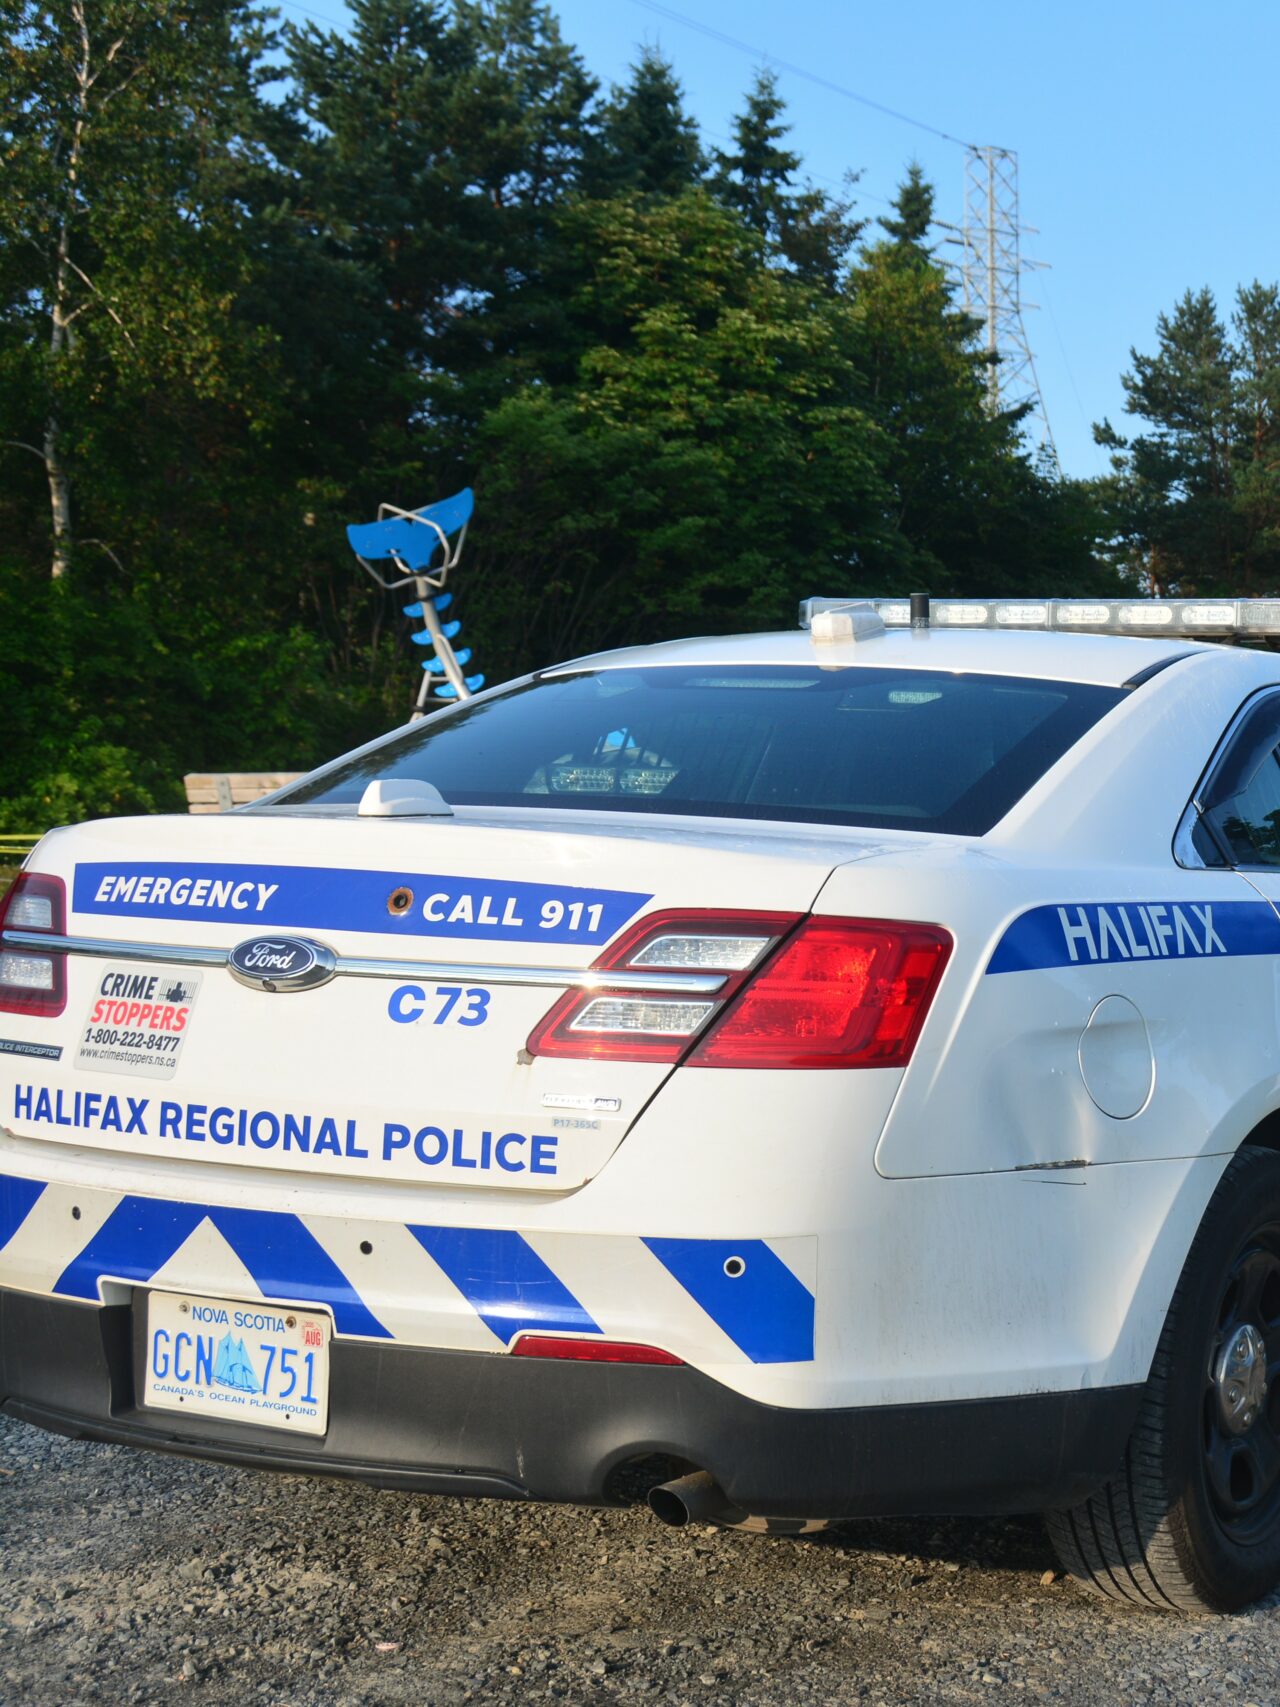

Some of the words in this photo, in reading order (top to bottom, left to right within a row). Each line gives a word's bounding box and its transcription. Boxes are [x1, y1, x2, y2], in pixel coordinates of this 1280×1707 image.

[94, 875, 279, 911] EMERGENCY
[421, 892, 524, 927] CALL
[538, 898, 604, 932] 911
[1056, 904, 1228, 962] HALIFAX
[244, 942, 297, 969] Ford
[99, 972, 159, 1000] CRIME
[90, 999, 190, 1032] STOPPERS
[15, 1044, 60, 1057] INTERCEPTOR
[84, 1027, 181, 1053] 1-800-222-8477
[79, 1047, 177, 1068] www.crimestoppers.ns.ca
[13, 1083, 150, 1136] HALIFAX
[159, 1102, 370, 1159] REGIONAL
[381, 1124, 559, 1175] POLICE
[192, 1305, 229, 1325] NOVA
[233, 1311, 286, 1333] SCOTIA
[304, 1329, 321, 1346] AUG
[152, 1328, 214, 1386] GCN
[260, 1344, 318, 1405] 751
[153, 1383, 205, 1398] CANADA'S
[209, 1391, 246, 1405] OCEAN
[249, 1398, 318, 1417] PLAYGROUND
